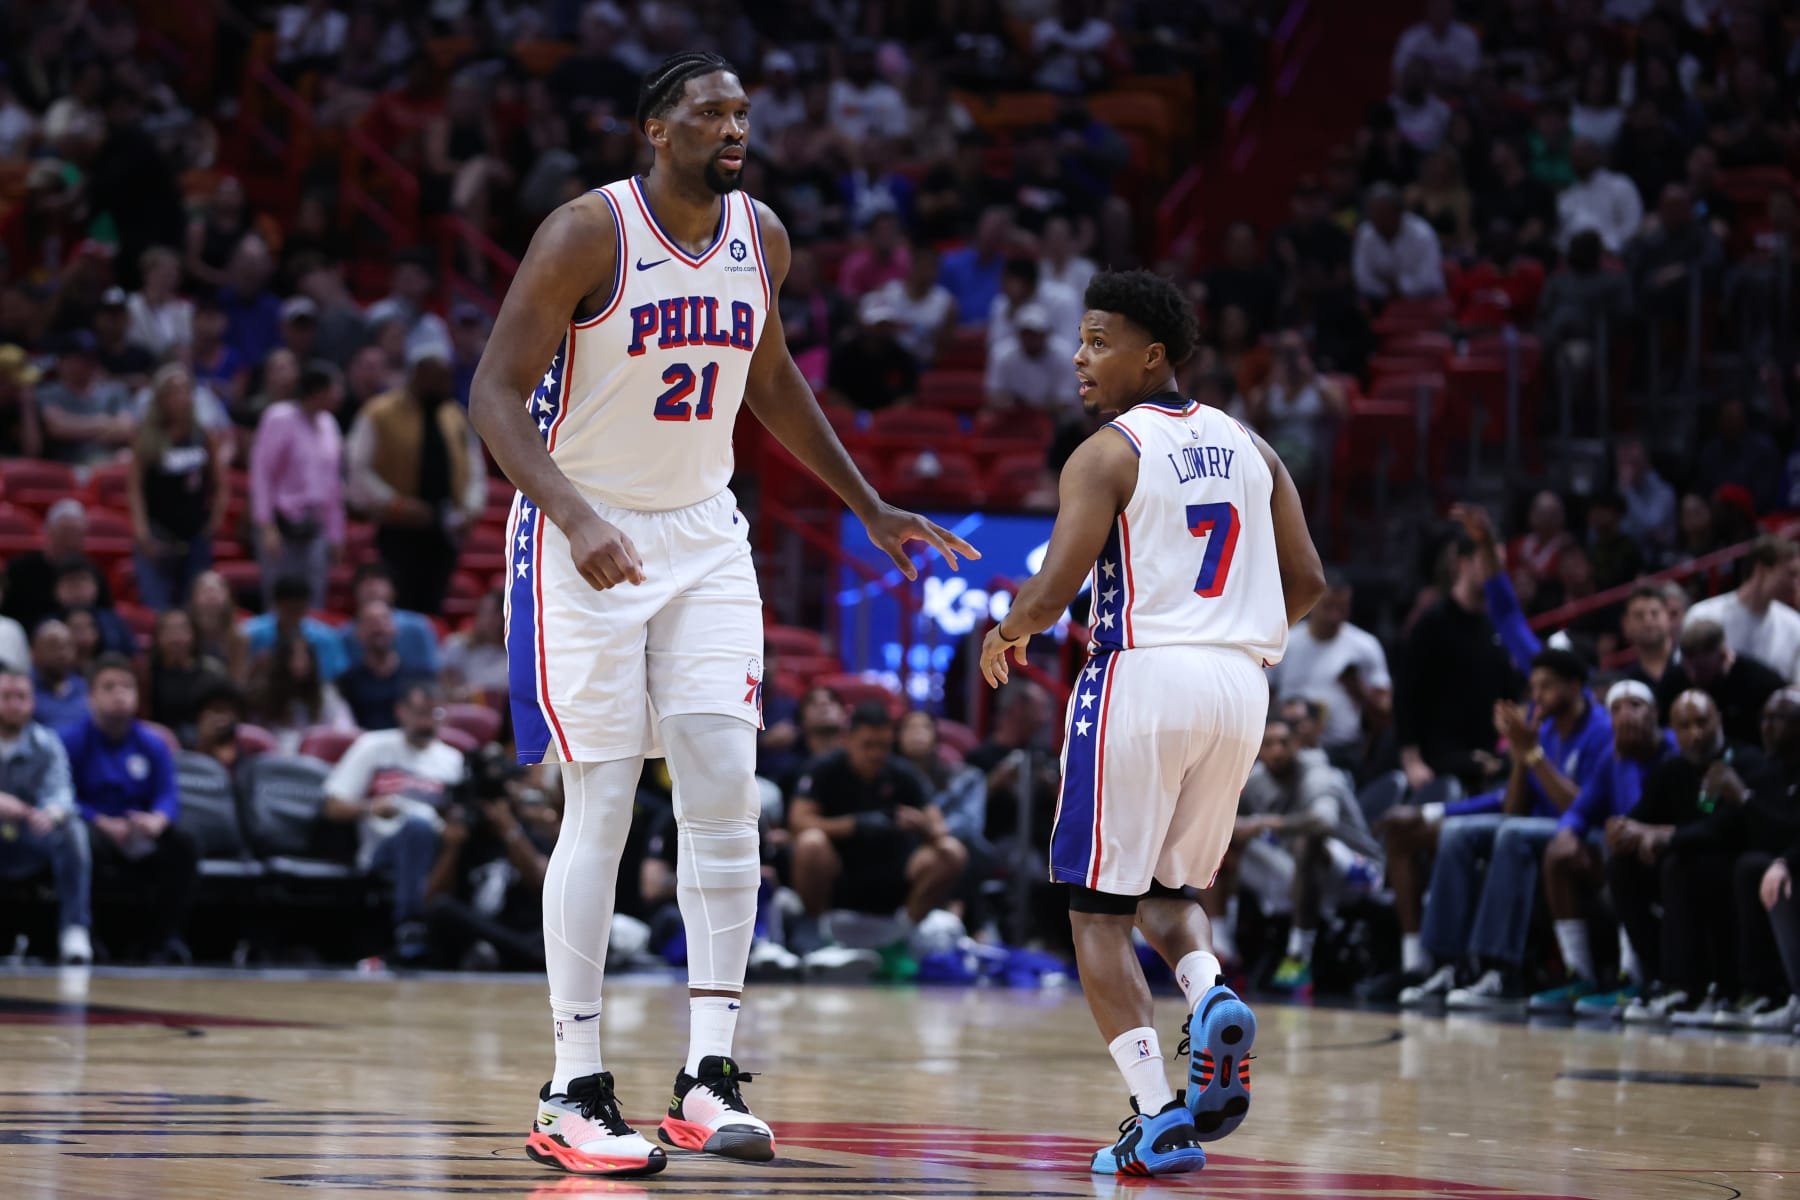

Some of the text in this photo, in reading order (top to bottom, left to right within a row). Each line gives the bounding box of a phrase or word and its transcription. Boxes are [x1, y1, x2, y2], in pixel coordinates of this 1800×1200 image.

[724, 265, 757, 273] crypto.com
[627, 296, 755, 357] PHILA
[653, 361, 719, 421] 21
[1167, 446, 1235, 485] LOWRY
[1186, 502, 1241, 598] 7
